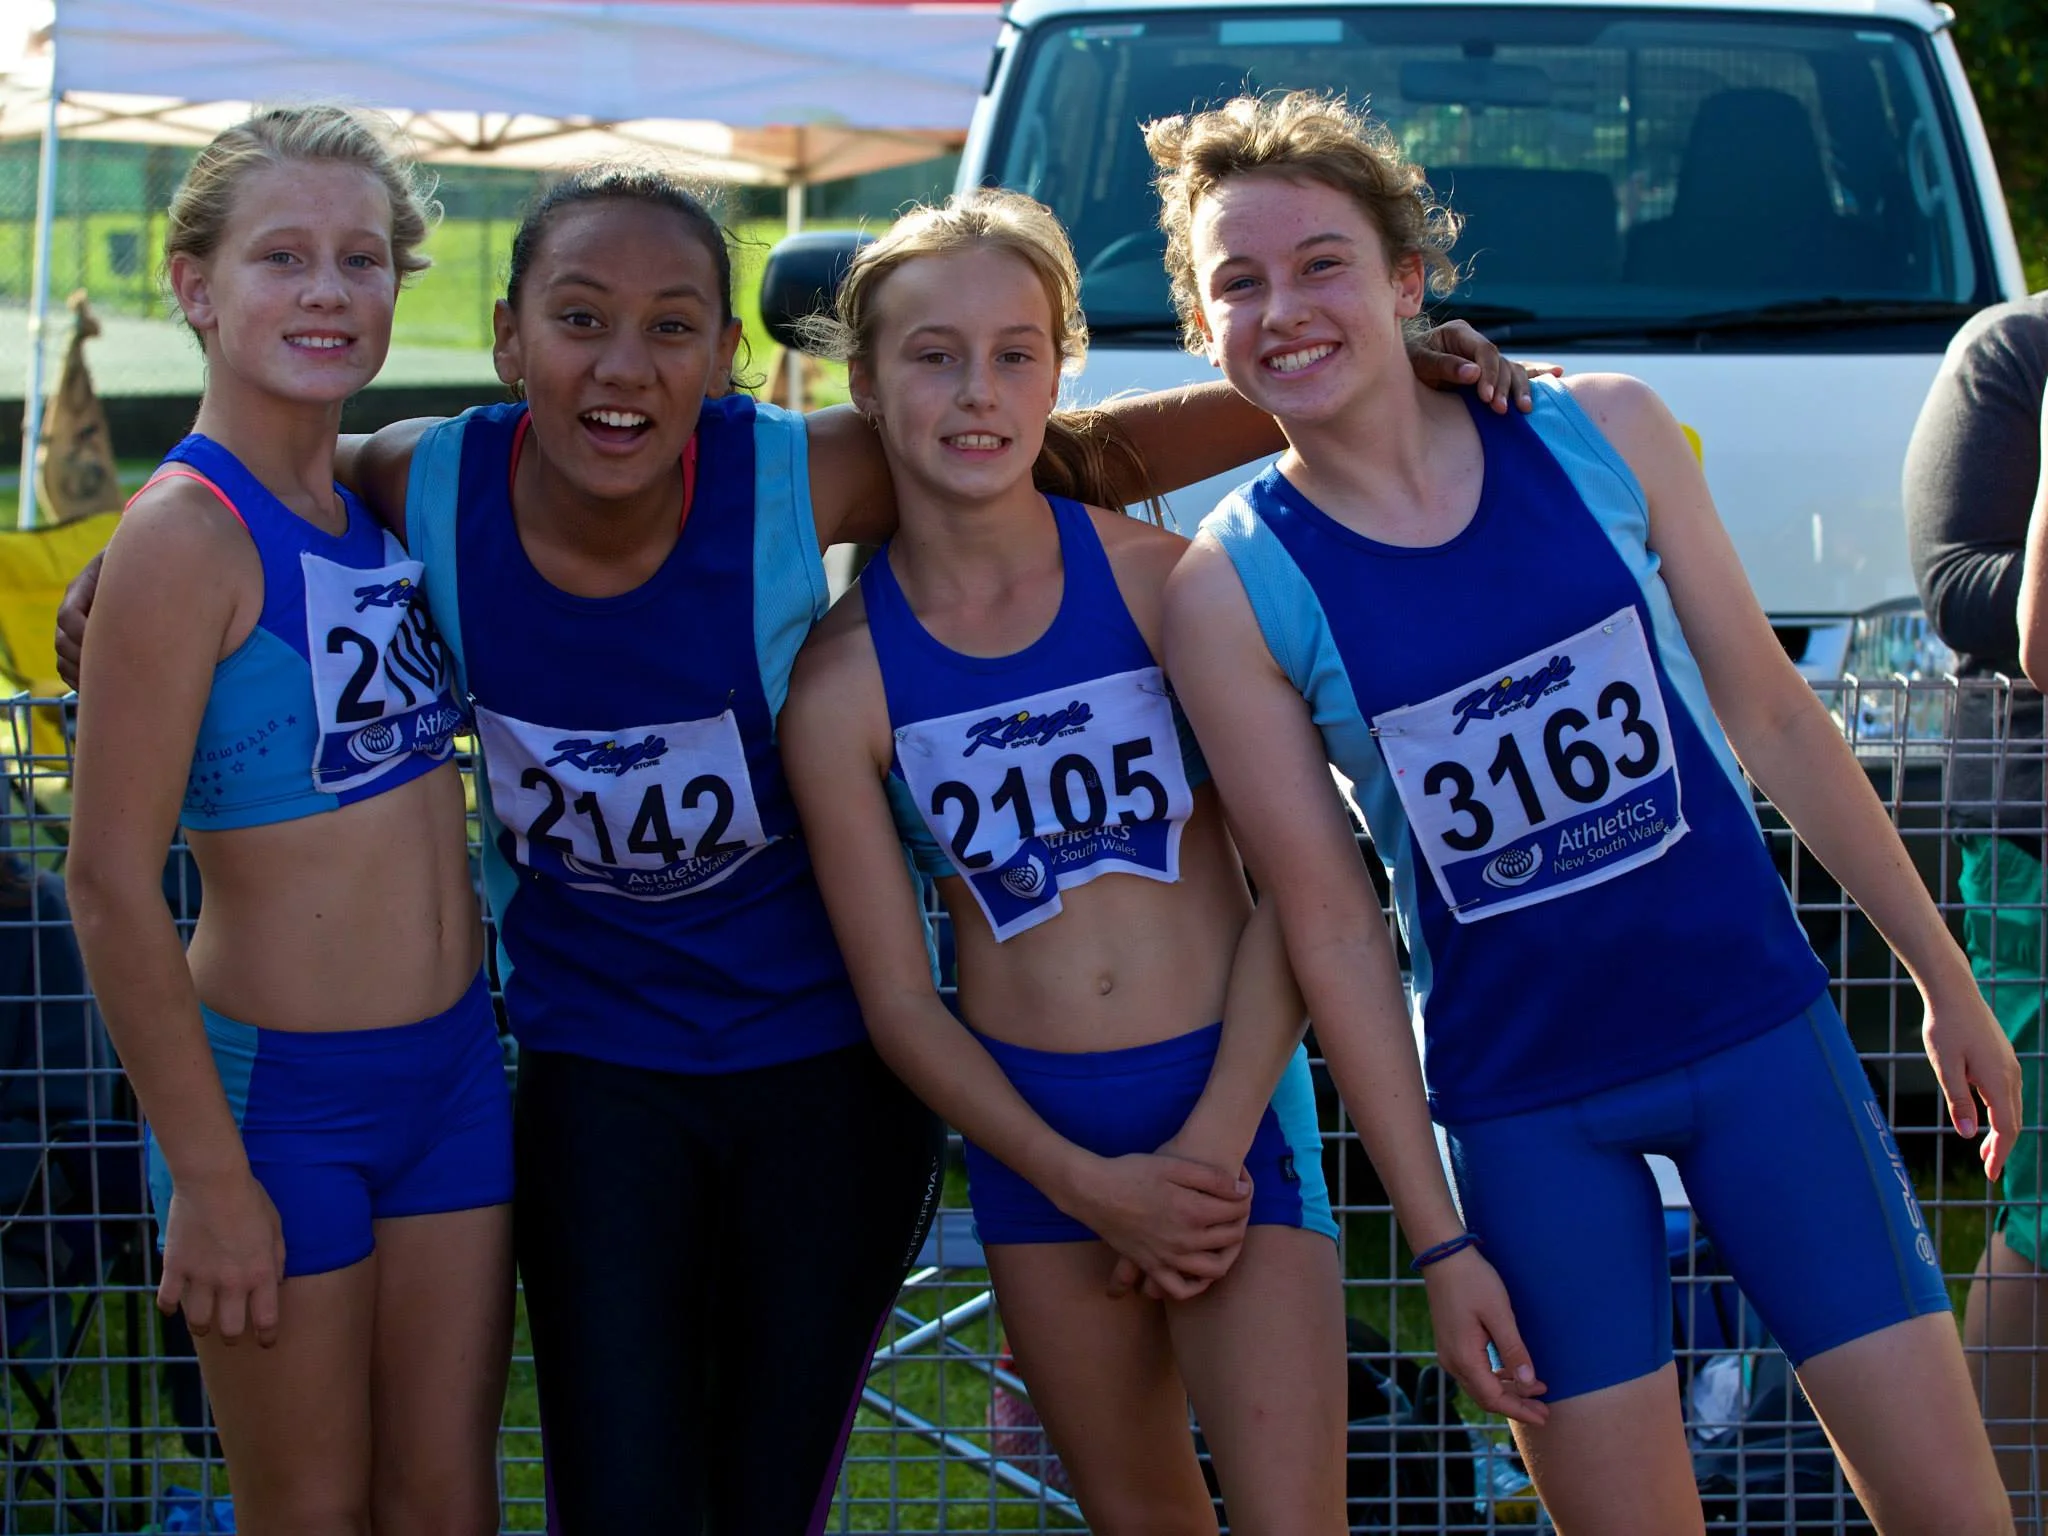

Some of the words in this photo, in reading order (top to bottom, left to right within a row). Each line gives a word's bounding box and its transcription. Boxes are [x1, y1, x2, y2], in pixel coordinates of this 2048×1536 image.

[1498, 699, 1527, 717] SPORT
[1543, 679, 1571, 697] STORE
[194, 719, 280, 763] lawarra
[963, 700, 1094, 758] King's
[1010, 737, 1039, 750] SPORT
[1058, 725, 1086, 738] STORE
[1423, 681, 1660, 851] 3163
[520, 767, 746, 865] 2142
[931, 736, 1169, 868] 2105
[1557, 798, 1657, 856] Athletics
[628, 855, 712, 885] Athleti
[1060, 840, 1098, 863] South
[1101, 838, 1137, 857] Wales
[1552, 855, 1585, 875] New
[1586, 835, 1628, 863] South
